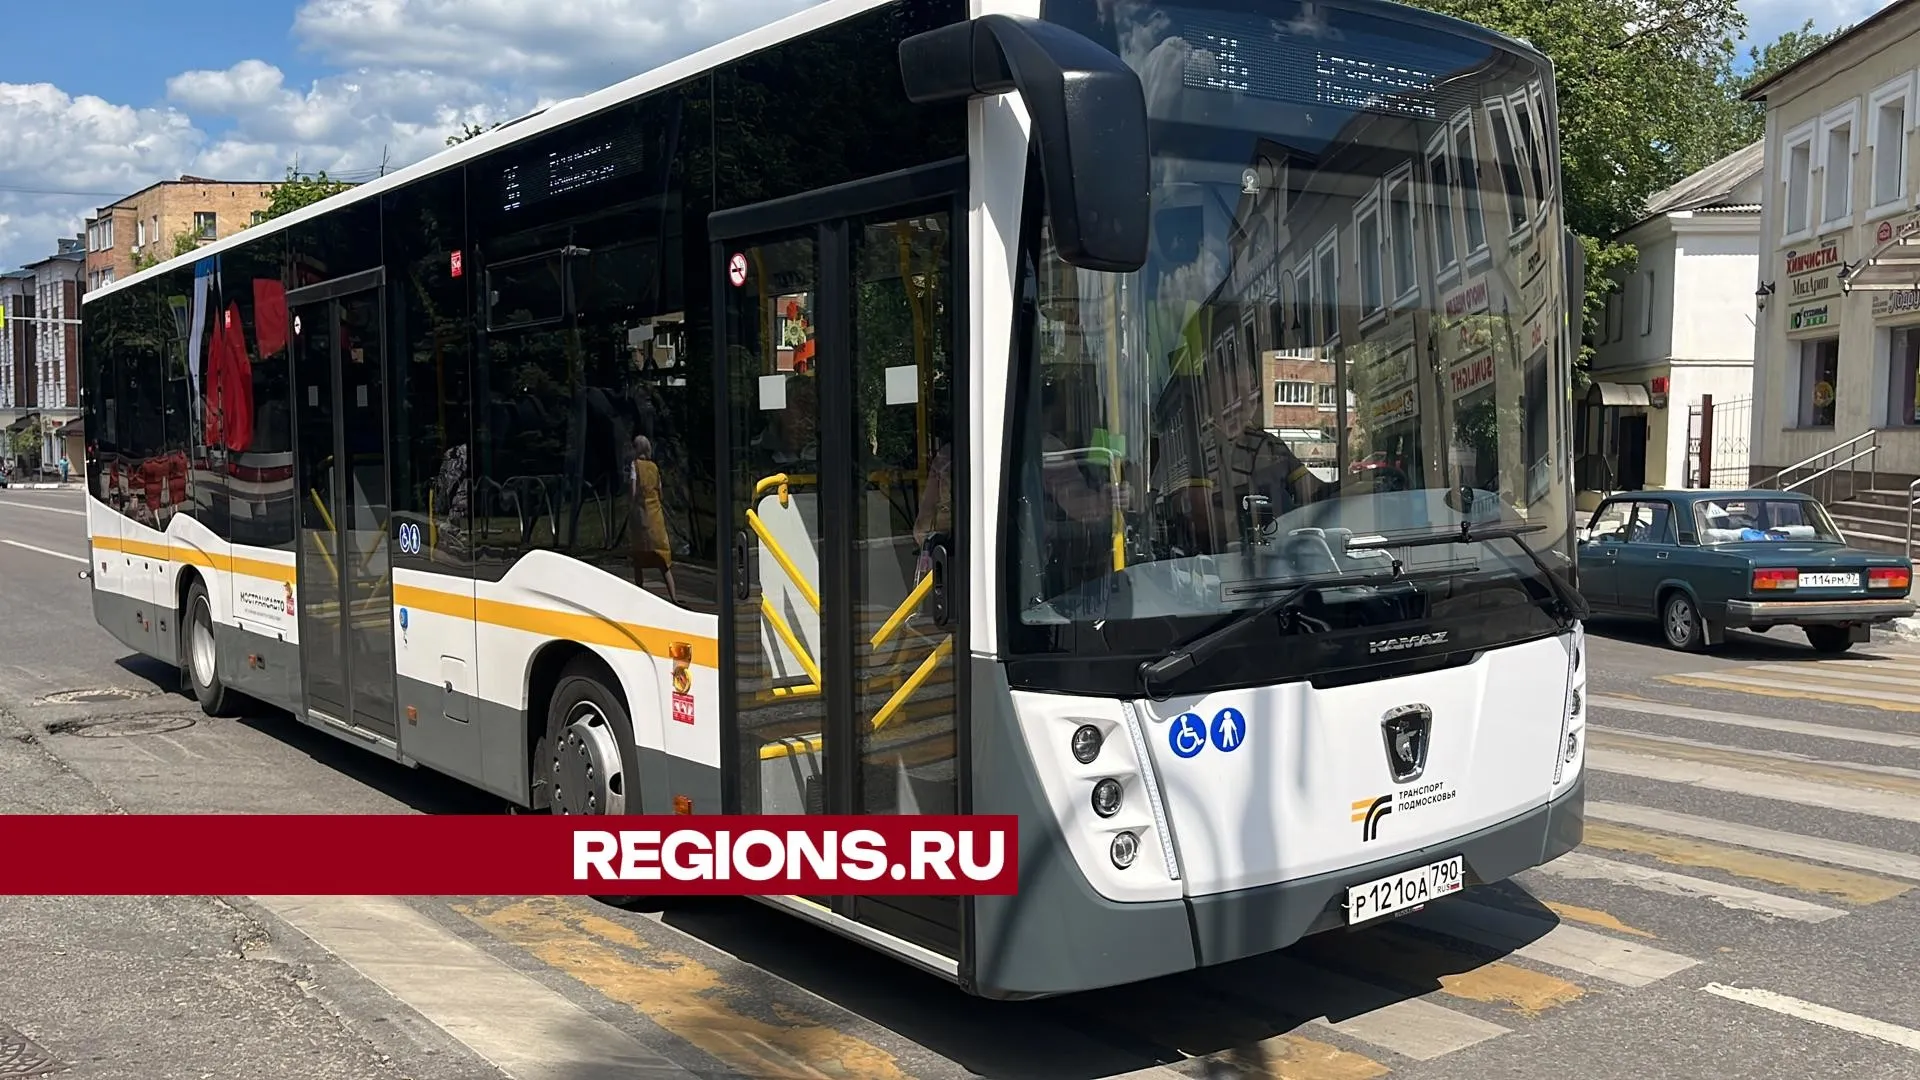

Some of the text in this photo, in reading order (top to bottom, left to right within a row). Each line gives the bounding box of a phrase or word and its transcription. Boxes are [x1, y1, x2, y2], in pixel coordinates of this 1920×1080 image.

[1787, 246, 1837, 275] ХИМЧИСТКА
[1369, 631, 1449, 654] KAMAZ
[1398, 781, 1444, 799] ТРАНСПОРТ
[1398, 790, 1457, 811] ПОДМОСКОВЬЯ
[1431, 860, 1458, 887] 790
[1437, 883, 1451, 894] RUS
